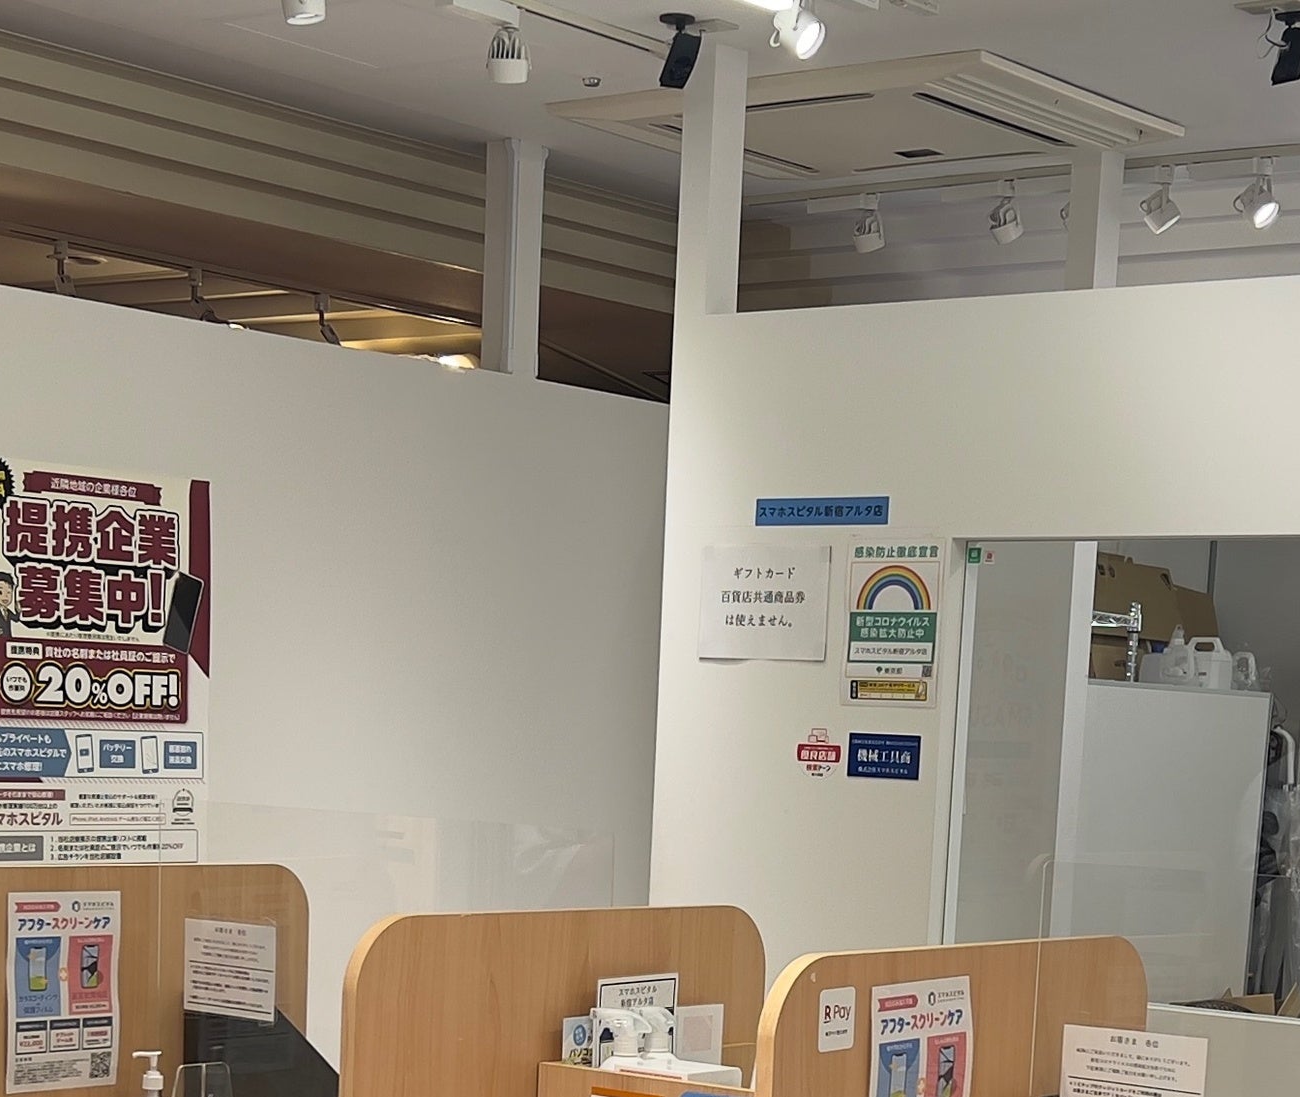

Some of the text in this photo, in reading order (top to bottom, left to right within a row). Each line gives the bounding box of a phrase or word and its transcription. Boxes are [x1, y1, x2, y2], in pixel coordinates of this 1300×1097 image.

[760, 505, 883, 518] スマホスピタル新宿アルタ店
[6, 500, 176, 566] 提携企業
[854, 546, 939, 559] 感染防止徹底宣言
[733, 566, 796, 579] ギフトカード
[19, 565, 165, 624] 募集中!
[721, 591, 805, 604] 百貨店共通商品券
[725, 614, 793, 628] は使えません。
[856, 616, 930, 627] 新型コロナウイルス
[860, 628, 924, 638] 感染拡大防止中
[854, 647, 927, 656] スマホスピタル新宿アルタ店
[37, 665, 178, 707] 20%OFF!
[857, 749, 911, 764] 機械工具商
[18, 917, 111, 931] アフタースクリーンケア
[619, 986, 657, 995] スマホスピタル
[824, 1005, 851, 1023] R Pay
[881, 1009, 963, 1035] アフタースクリーンケア
